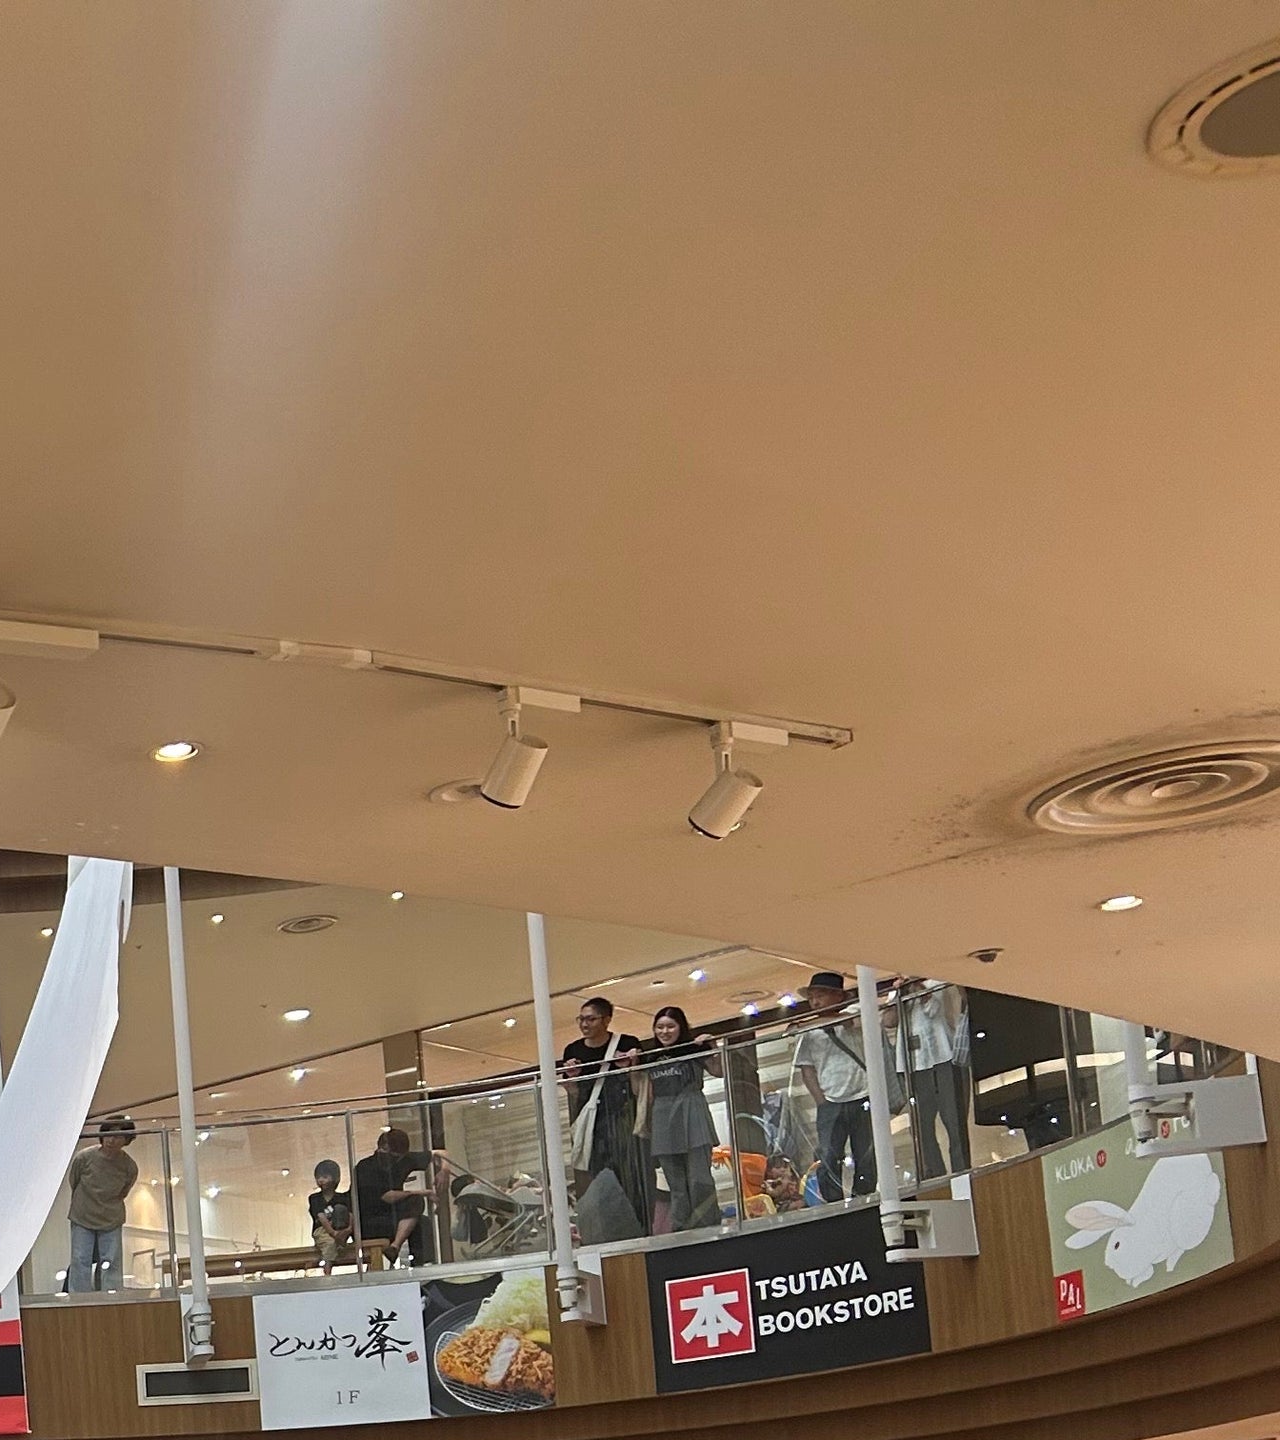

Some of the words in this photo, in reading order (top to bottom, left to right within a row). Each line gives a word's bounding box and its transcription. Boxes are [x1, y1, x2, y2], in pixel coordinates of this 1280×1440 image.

[1055, 1156, 1094, 1183] KLOKA
[755, 1261, 868, 1300] TSUTAYA
[1058, 1279, 1082, 1310] PAL
[680, 1284, 743, 1348] 本
[758, 1287, 914, 1336] BOOKSTORE
